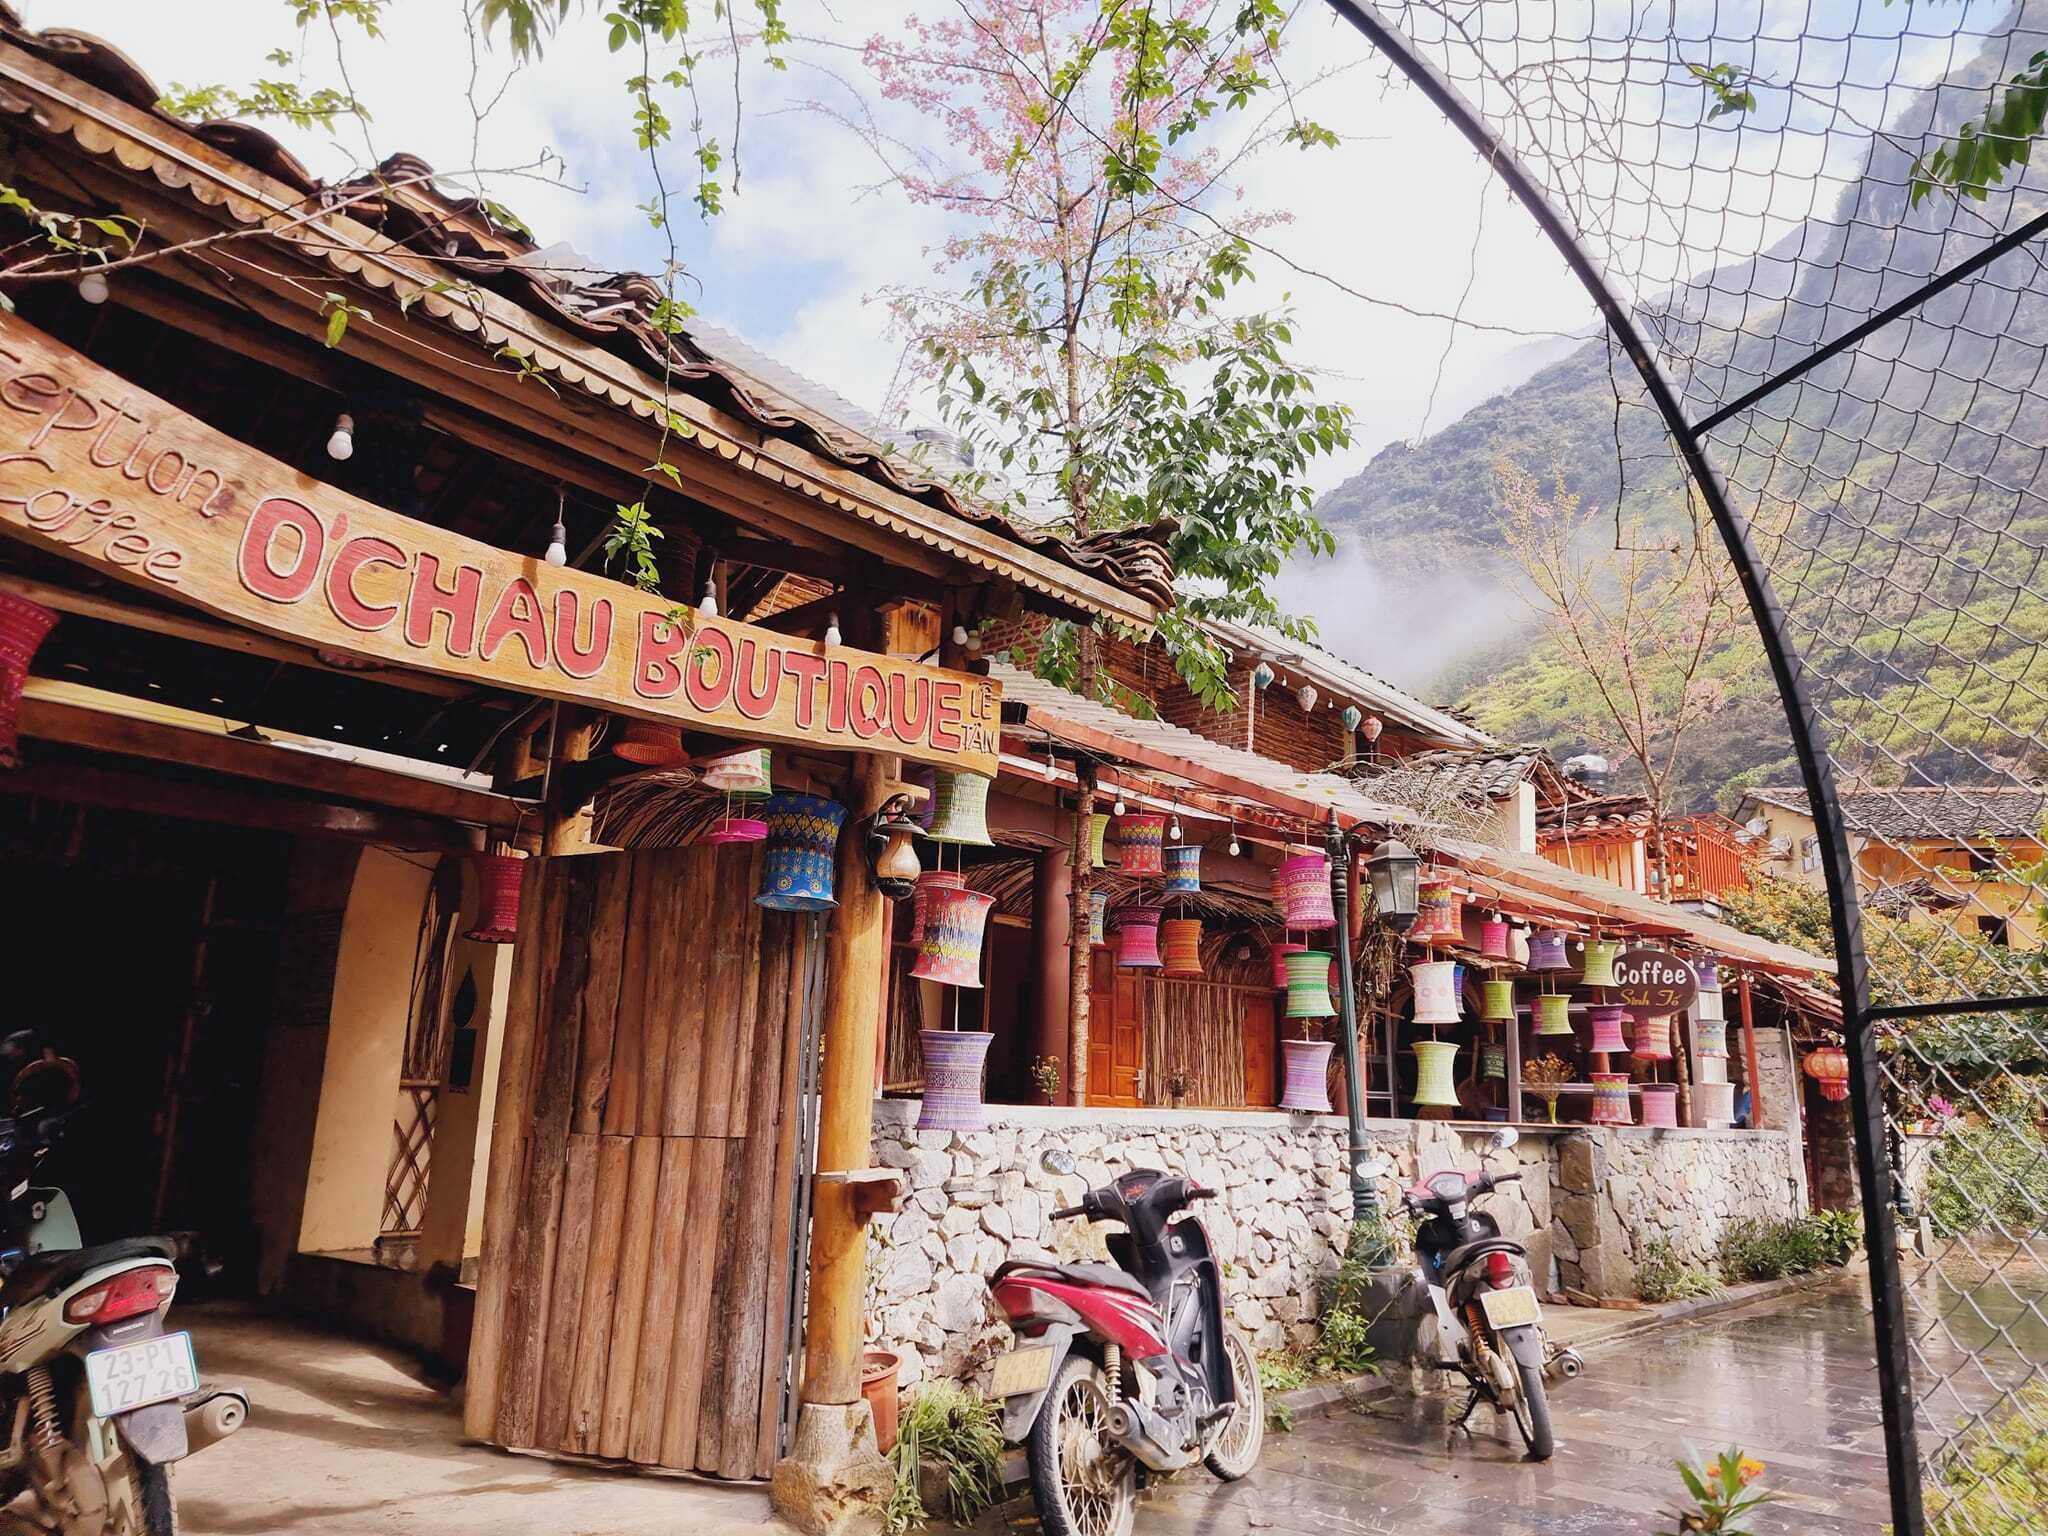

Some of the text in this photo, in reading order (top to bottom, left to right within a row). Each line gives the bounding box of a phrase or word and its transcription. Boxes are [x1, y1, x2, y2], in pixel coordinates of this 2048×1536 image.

[0, 349, 224, 518] eption
[237, 497, 964, 753] O'CHAU BOUTIQUE
[1614, 961, 1688, 985] Coffee
[104, 1341, 174, 1380] 23-P1
[102, 1366, 189, 1410] 127.26
